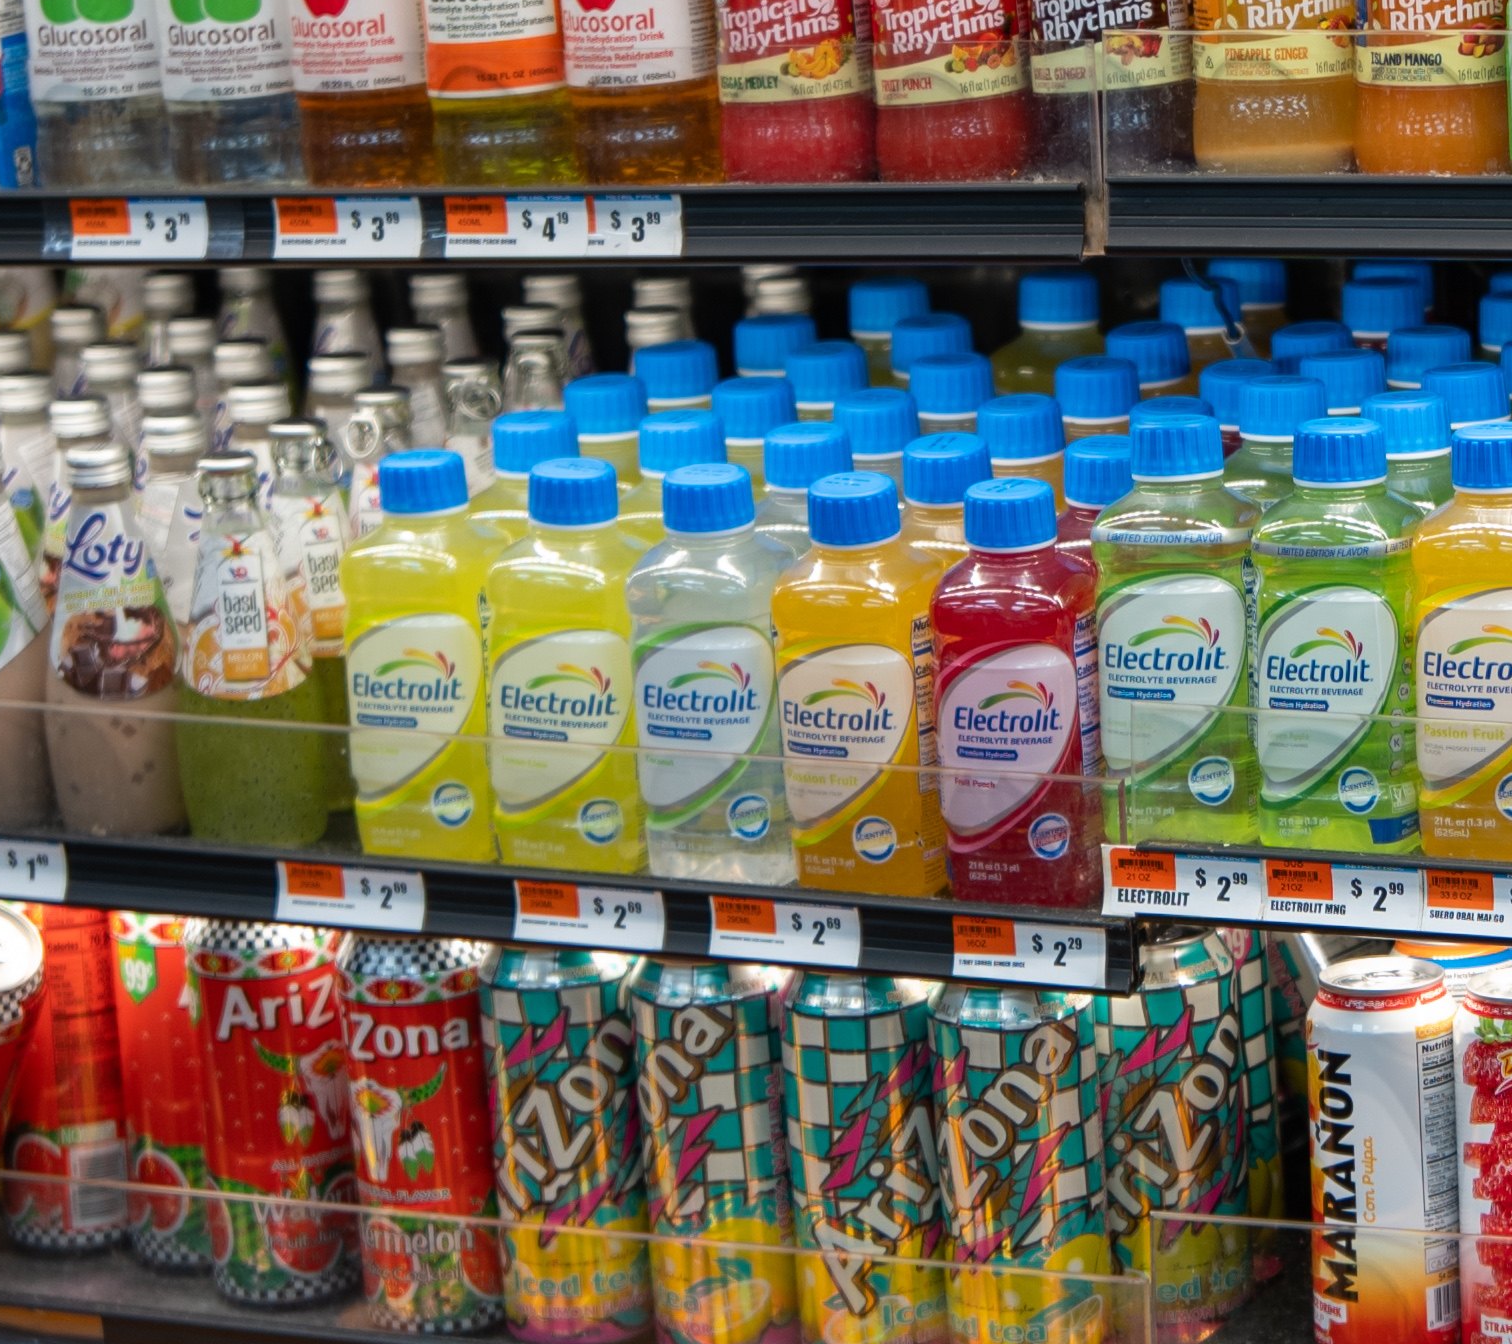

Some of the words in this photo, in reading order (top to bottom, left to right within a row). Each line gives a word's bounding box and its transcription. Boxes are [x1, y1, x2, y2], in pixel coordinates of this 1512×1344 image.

[66, 515, 143, 580] Loty
[1107, 531, 1140, 544] LIMITED
[1142, 530, 1182, 543] EDITION
[1186, 530, 1222, 542] FLAVOR
[1267, 656, 1374, 684] Electrolit
[1270, 685, 1317, 695] ELECTROLYTE
[1321, 686, 1363, 697] BEVERAGE
[1270, 900, 1320, 914] ELECTROLIT
[1324, 903, 1346, 914] MNG
[1314, 1048, 1358, 1303] MARAÑON
